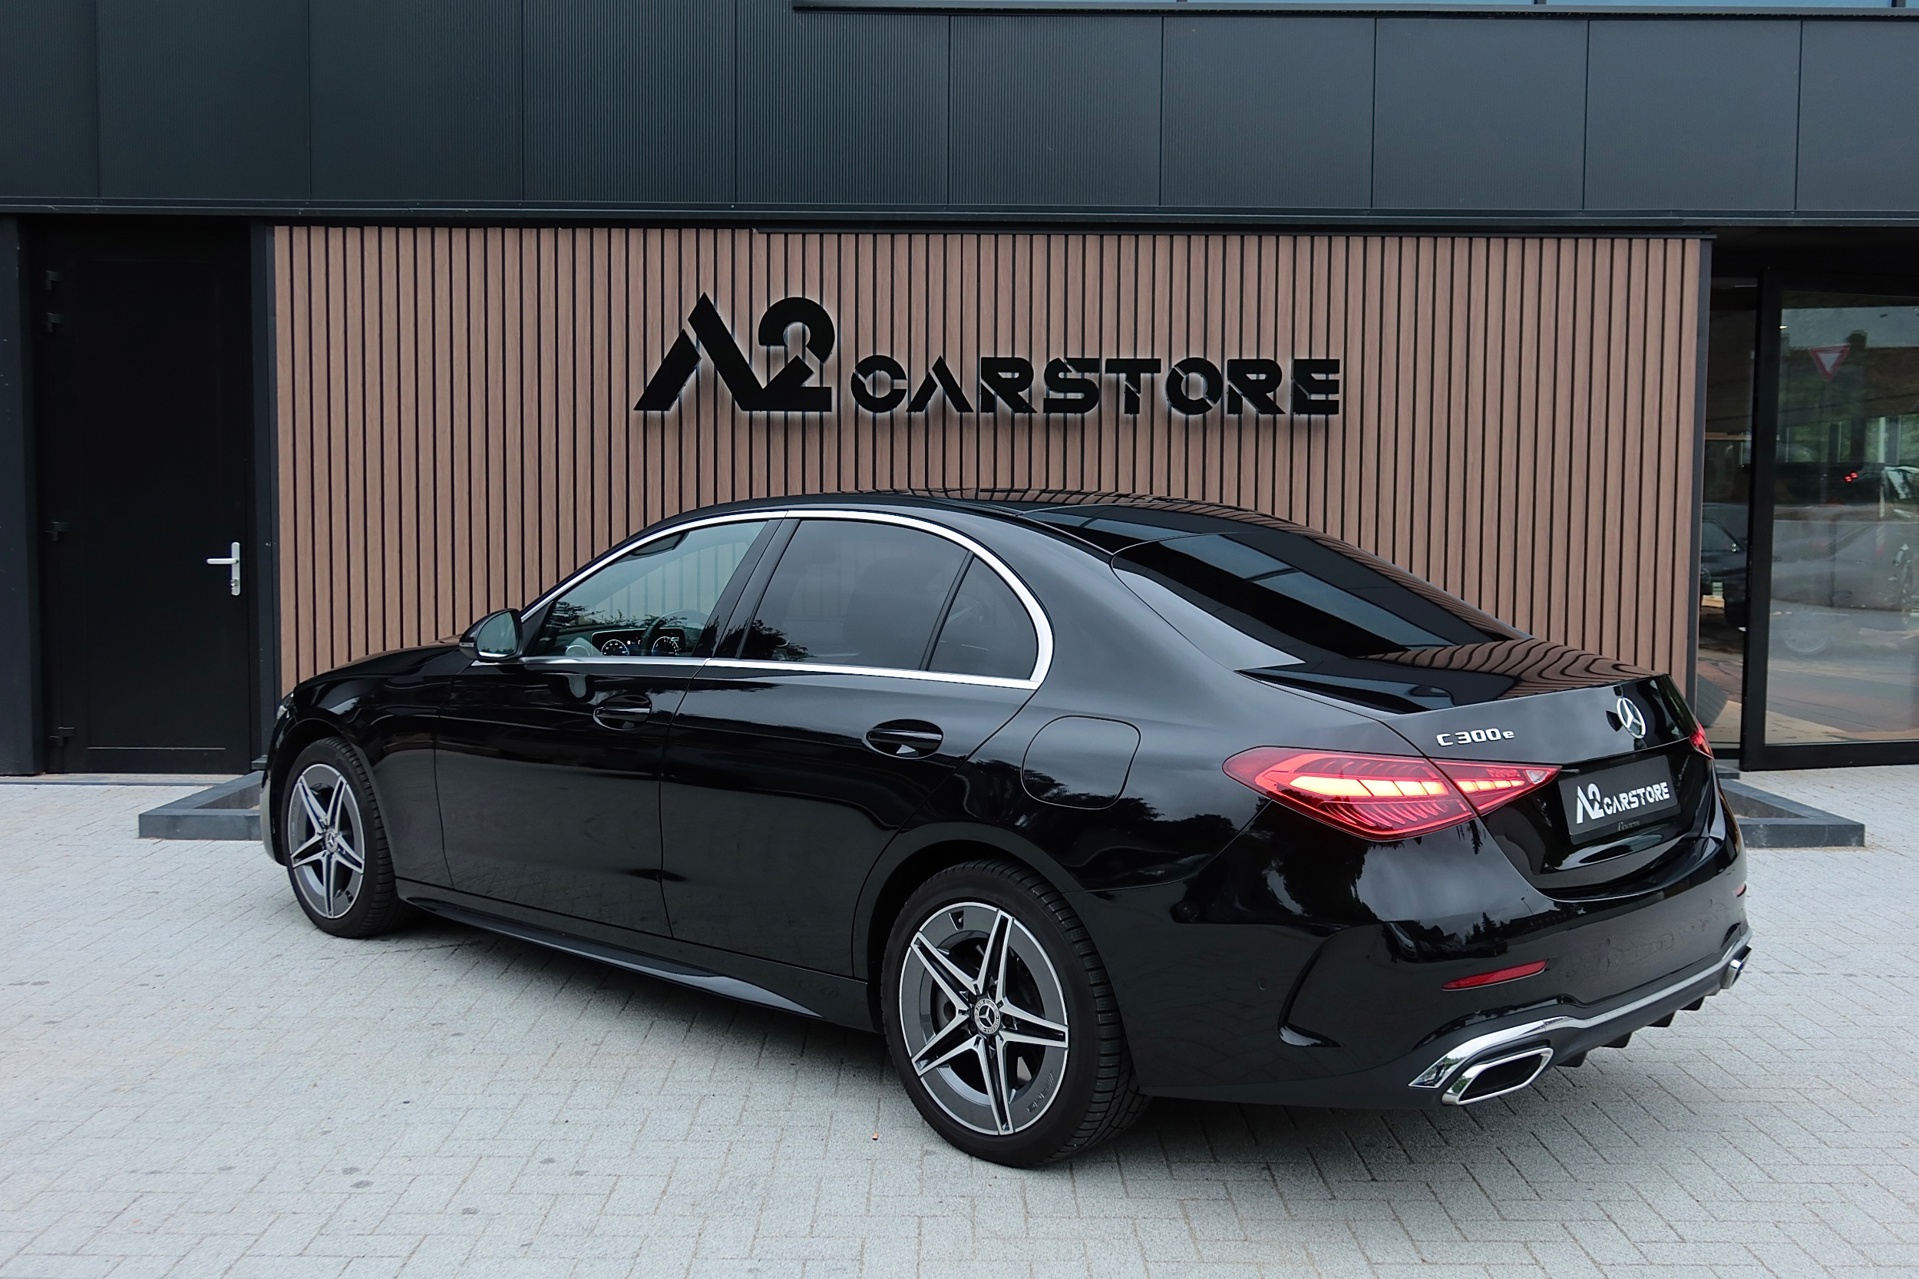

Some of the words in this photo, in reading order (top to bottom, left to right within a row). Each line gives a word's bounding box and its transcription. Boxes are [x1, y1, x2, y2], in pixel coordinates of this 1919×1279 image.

[633, 292, 835, 411] A2
[851, 355, 1340, 415] CARSTORE
[1576, 783, 1605, 825] A2
[1603, 781, 1671, 815] CARSTORE
